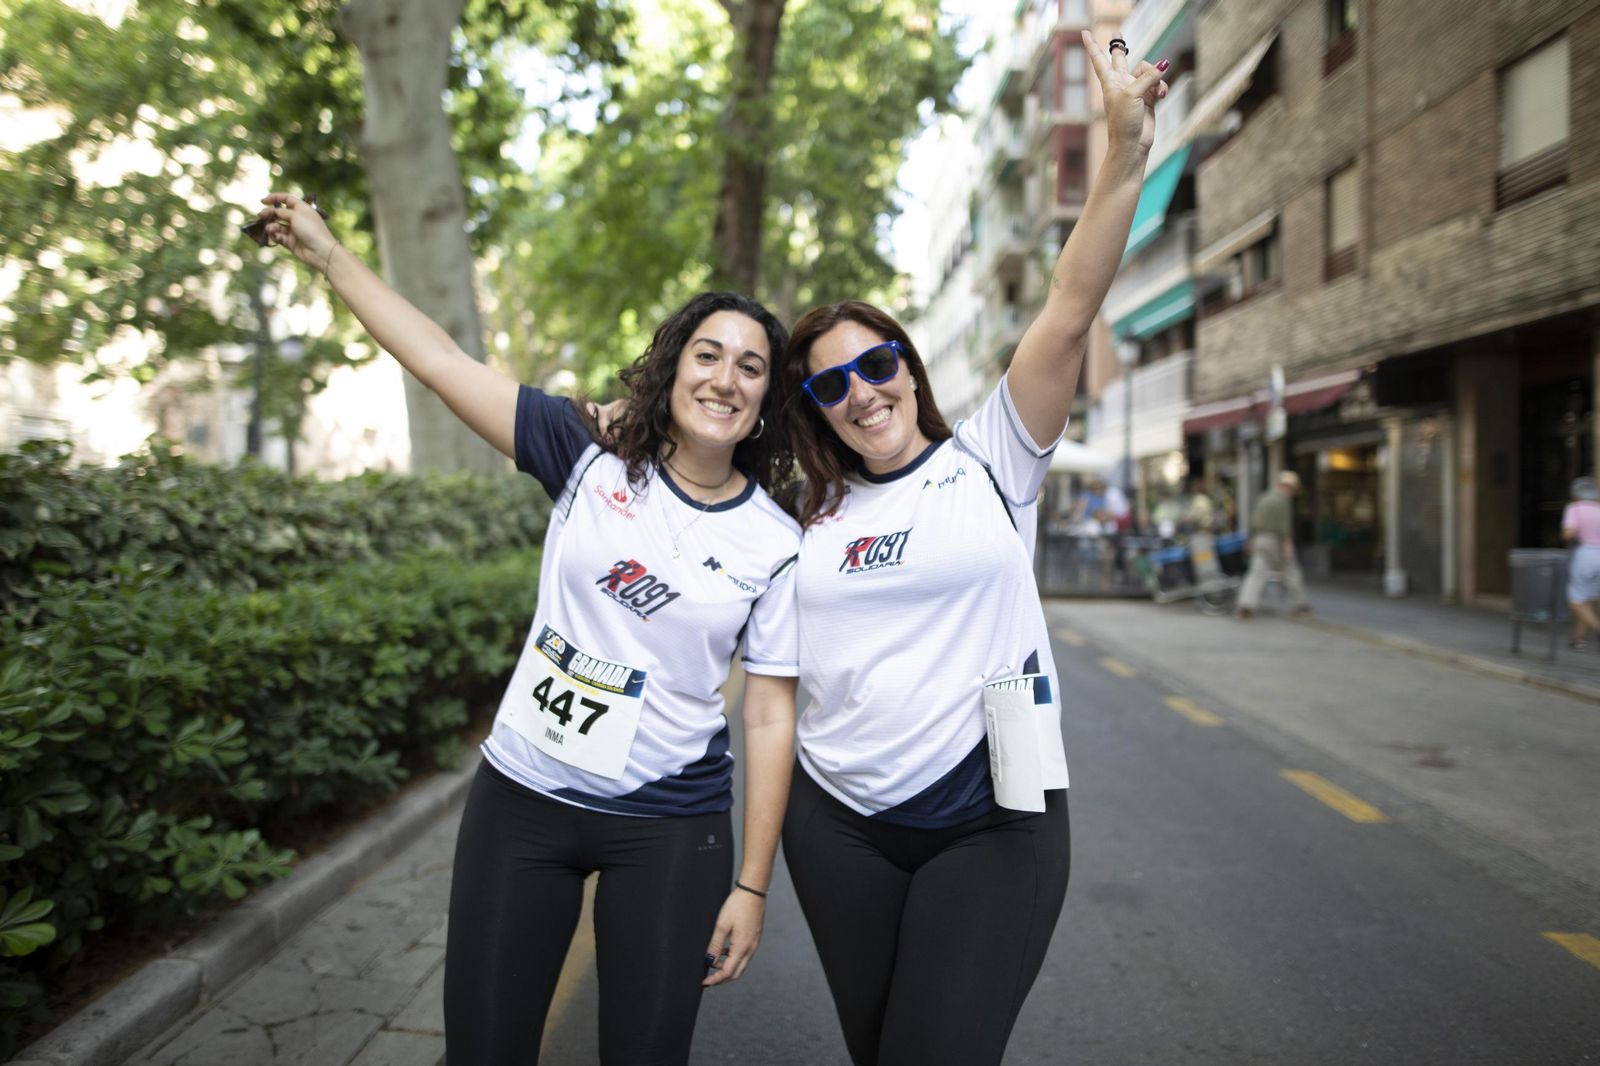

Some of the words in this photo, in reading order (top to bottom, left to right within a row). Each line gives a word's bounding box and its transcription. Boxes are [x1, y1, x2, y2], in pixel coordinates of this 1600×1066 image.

[593, 485, 636, 520] Santander
[567, 651, 634, 689] GRANADA
[532, 676, 610, 736] 447
[545, 727, 564, 746] INMA
